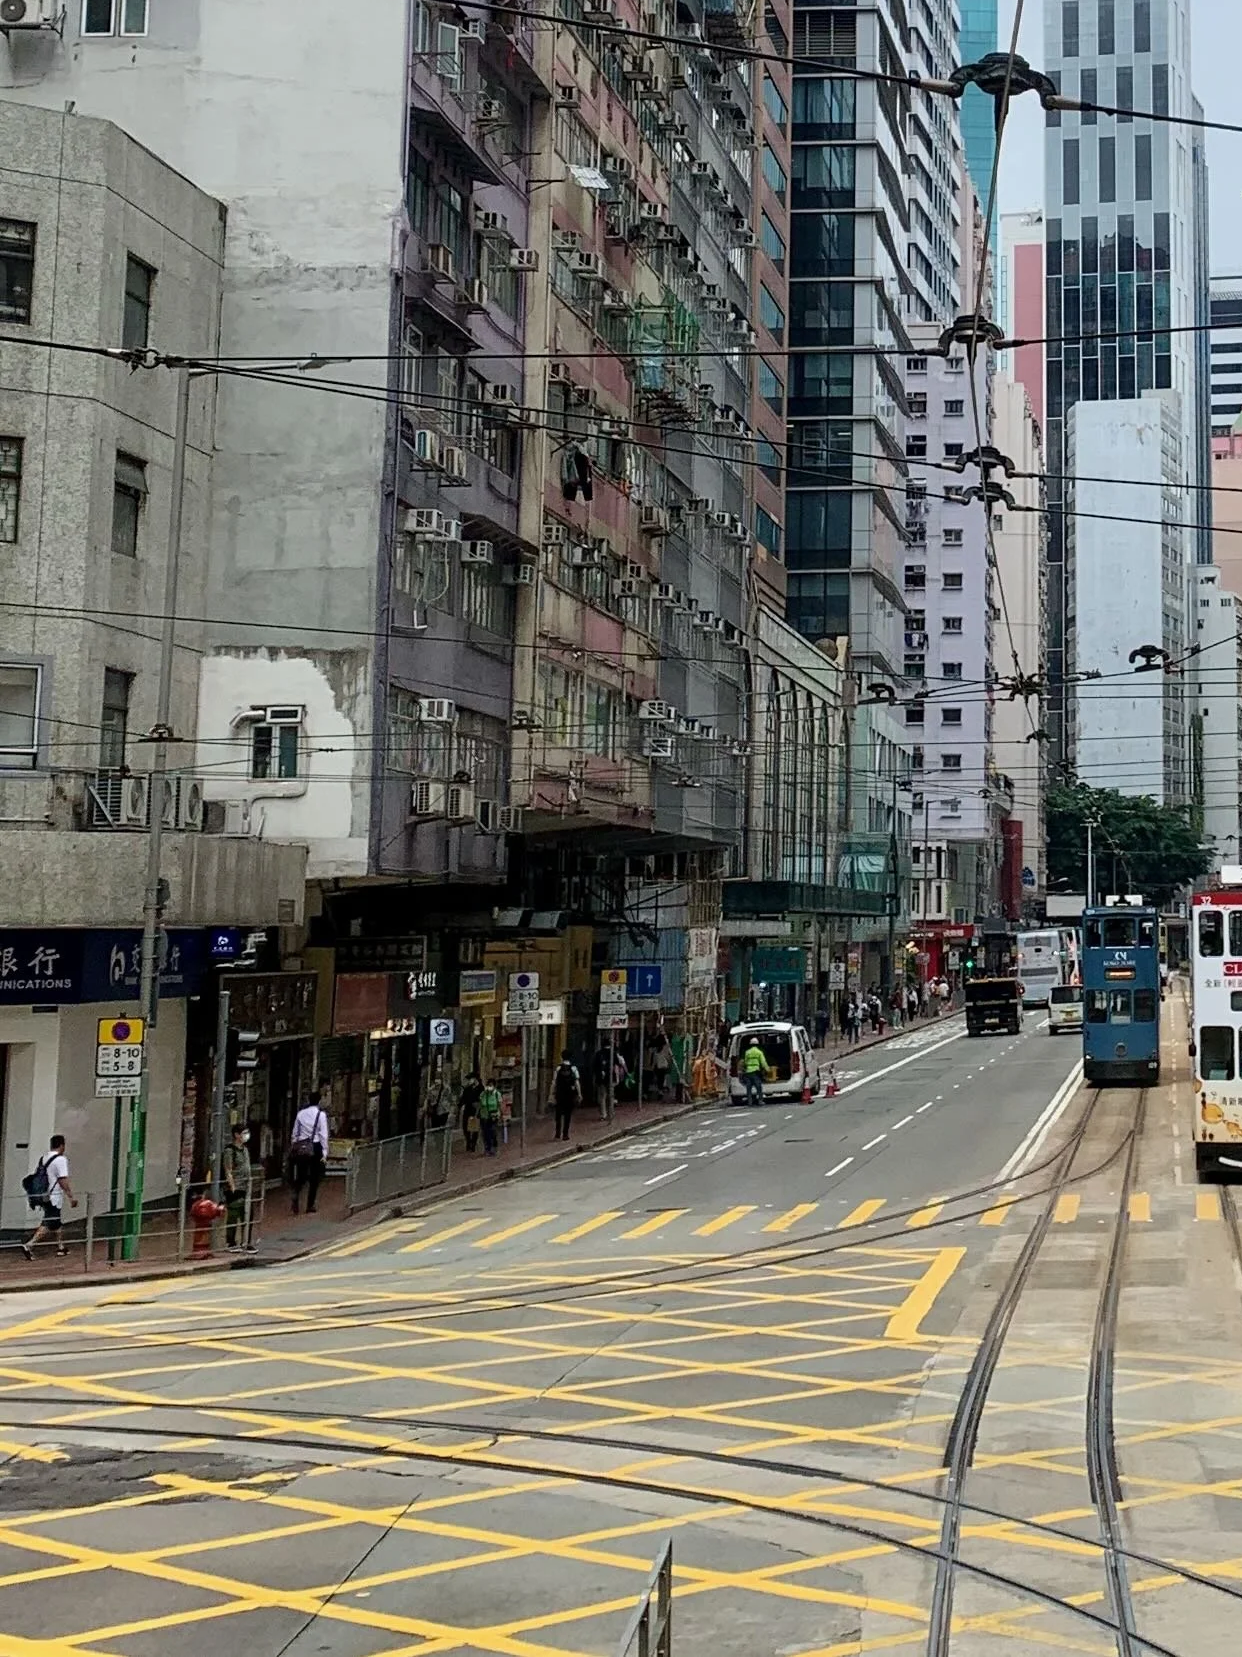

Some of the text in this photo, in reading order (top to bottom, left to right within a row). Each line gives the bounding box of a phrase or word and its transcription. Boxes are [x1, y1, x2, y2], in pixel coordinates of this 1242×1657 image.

[1200, 896, 1212, 905] 32
[113, 1048, 140, 1059] 8-10
[112, 1061, 135, 1072] 5-8
